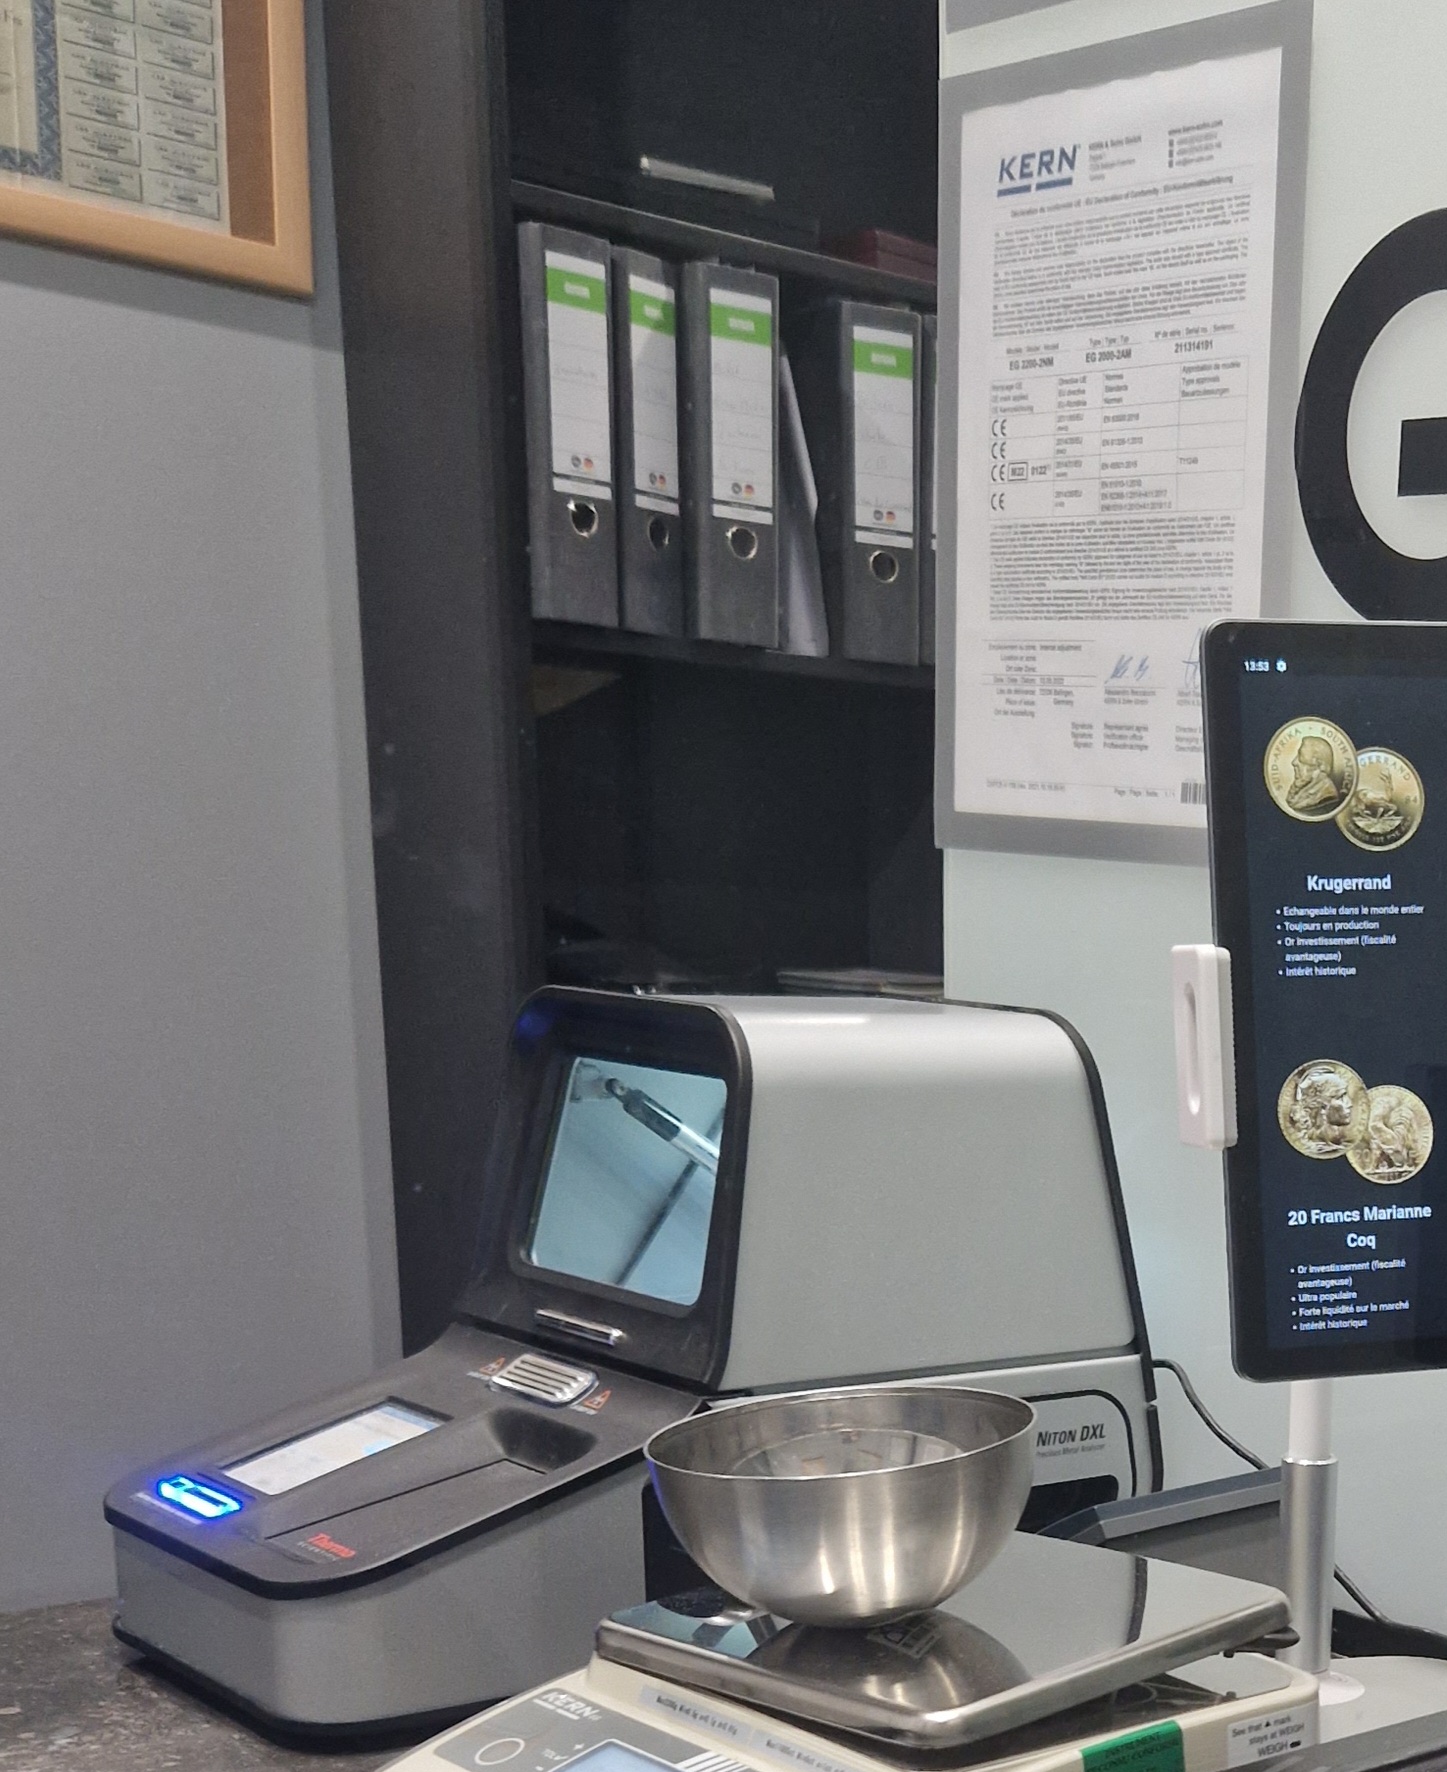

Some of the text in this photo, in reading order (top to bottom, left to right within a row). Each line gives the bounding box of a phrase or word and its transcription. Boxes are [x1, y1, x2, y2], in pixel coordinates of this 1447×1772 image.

[998, 144, 1078, 183] KERN
[1244, 660, 1270, 672] 13:53
[1307, 874, 1391, 894] Krugerrand
[1283, 904, 1425, 918] Echangeable dans le monde entier
[1284, 920, 1380, 932] Toujours en production
[1284, 937, 1295, 947] Or
[1297, 936, 1359, 946] investissement
[1285, 951, 1342, 963] avantageuse)
[1315, 966, 1357, 977] historique
[1288, 1204, 1432, 1226] 20 Francs Marianne
[1347, 1233, 1376, 1249] Coq
[1297, 1265, 1307, 1274] Or
[1080, 1423, 1106, 1441] DXL
[543, 1692, 599, 1717] KERN
[1232, 1714, 1292, 1739] See that mark
[1279, 1722, 1306, 1738] WEIGH
[1256, 1741, 1289, 1758] WEIGH
